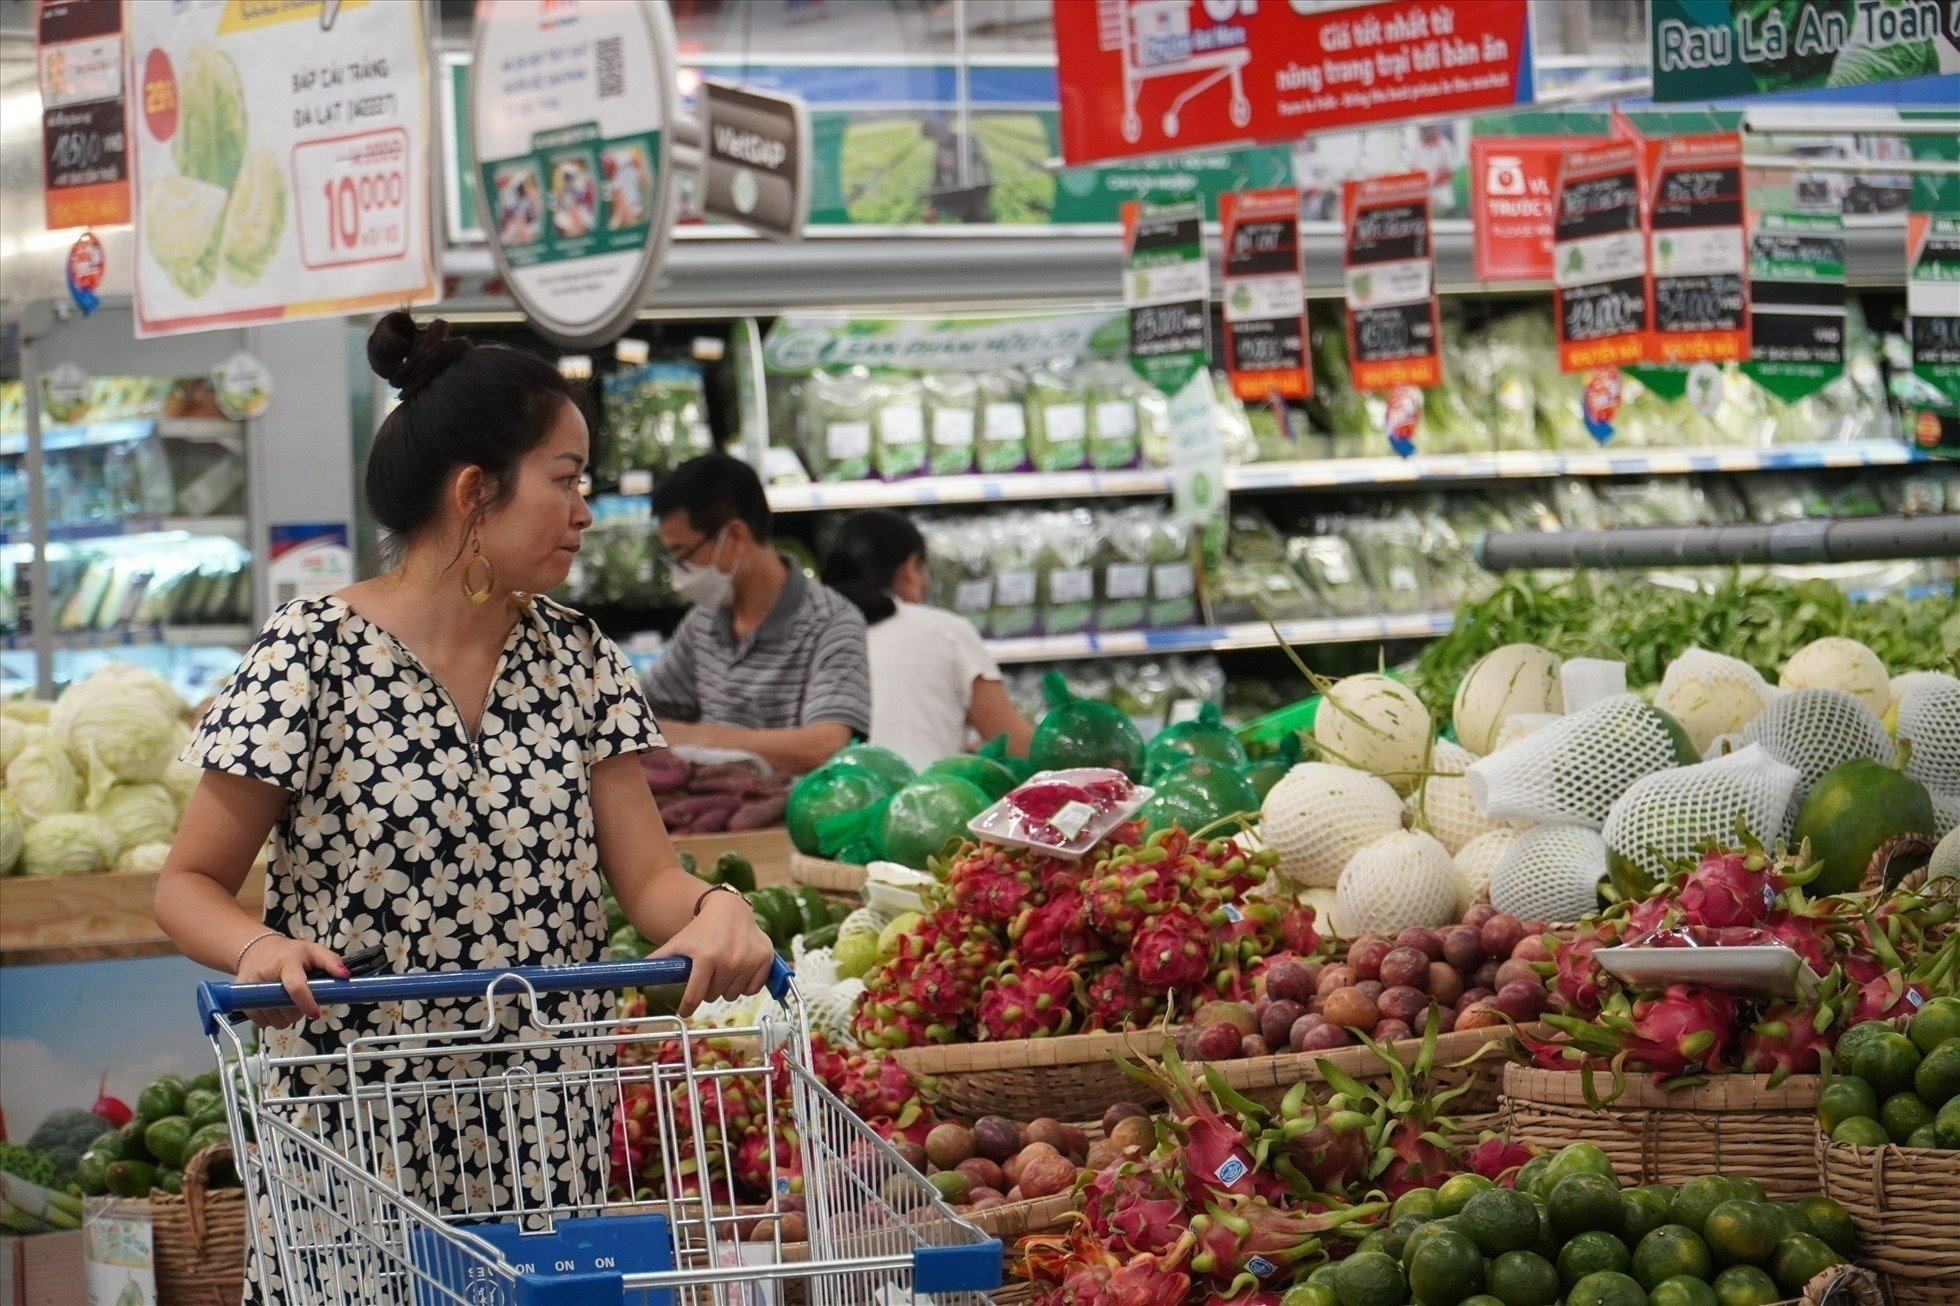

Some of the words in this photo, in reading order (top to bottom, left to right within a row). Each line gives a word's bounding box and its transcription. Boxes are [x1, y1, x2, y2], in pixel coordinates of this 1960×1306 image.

[1660, 20, 1731, 70] Rau
[1739, 10, 1786, 61] Lá
[1796, 5, 1847, 54] An
